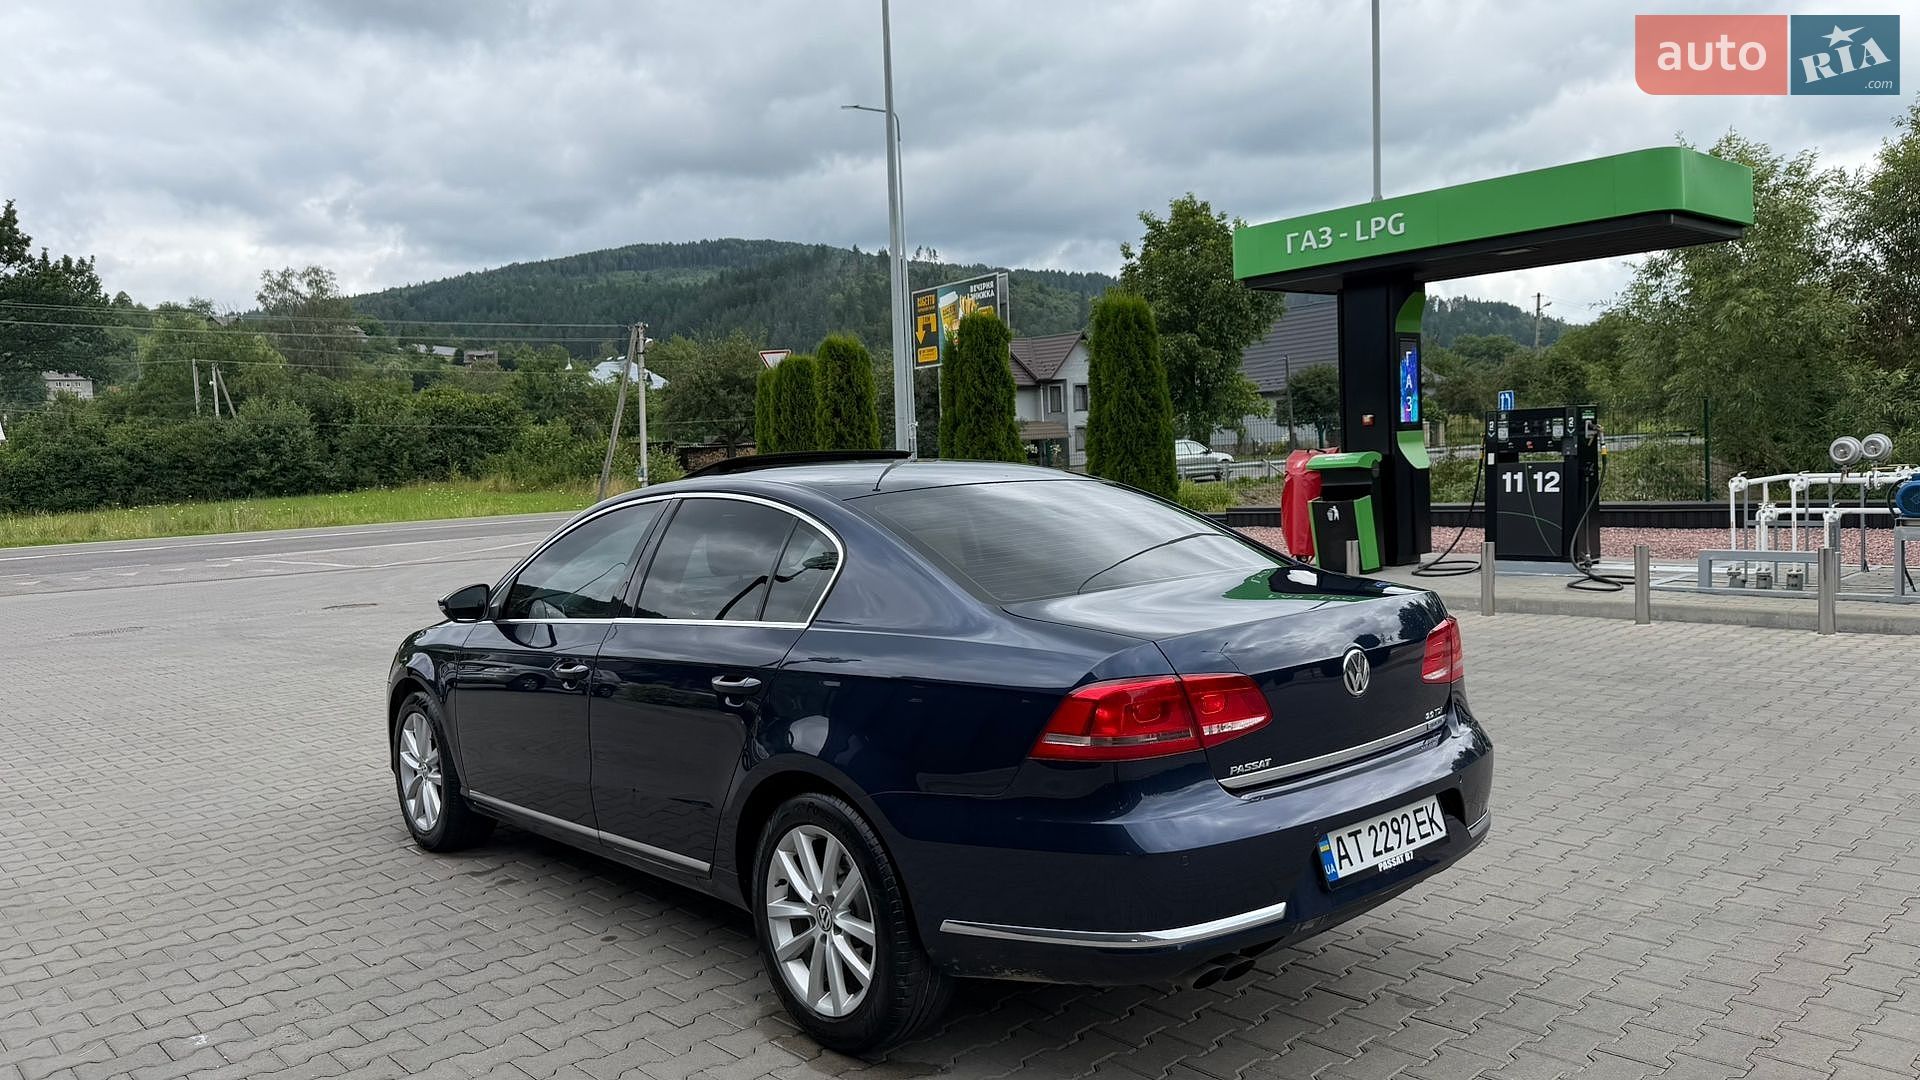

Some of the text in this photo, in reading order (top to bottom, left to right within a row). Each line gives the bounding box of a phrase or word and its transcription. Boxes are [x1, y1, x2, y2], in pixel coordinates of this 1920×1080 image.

[1286, 226, 1333, 255] ГАЗ
[1356, 212, 1405, 241] LPG
[1502, 471, 1561, 493] 11 12
[1229, 757, 1272, 776] PASSAT
[1335, 802, 1444, 871] AT 2292 EK
[1324, 865, 1337, 875] UA
[1377, 855, 1404, 873] PASSAT
